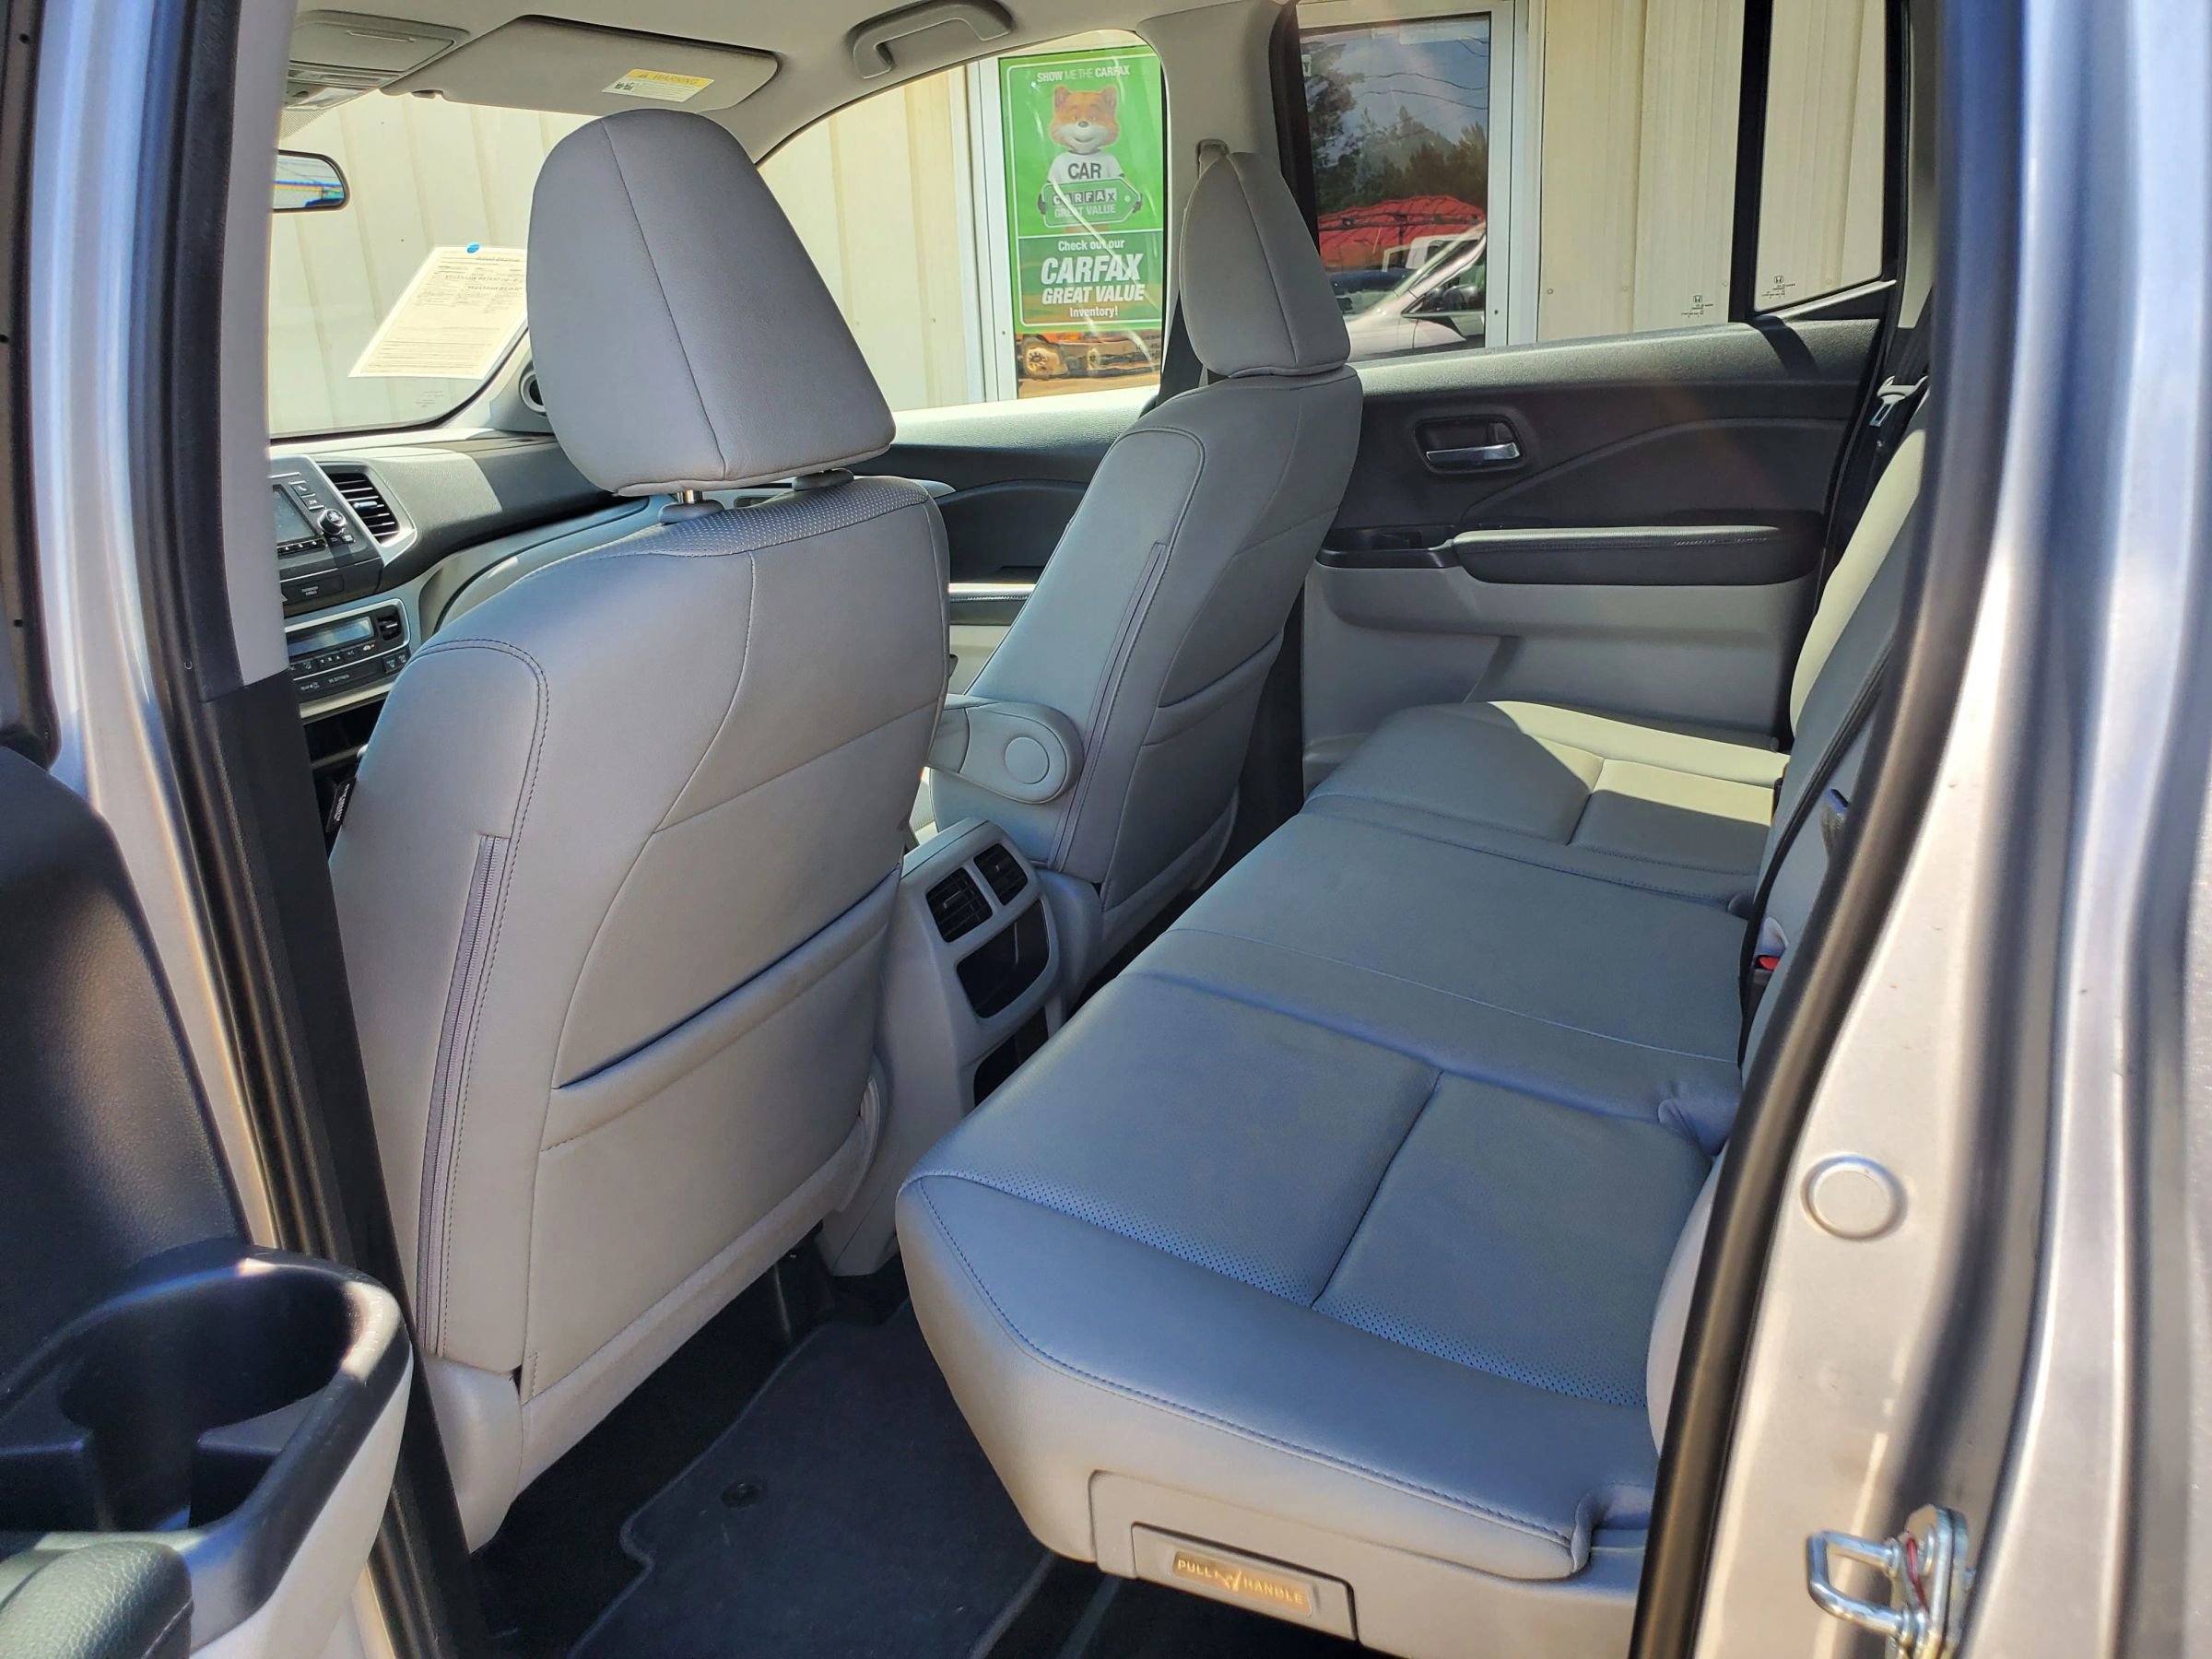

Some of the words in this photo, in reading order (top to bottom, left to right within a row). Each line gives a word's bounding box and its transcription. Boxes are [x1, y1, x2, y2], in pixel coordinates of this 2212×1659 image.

[1037, 70, 1064, 82] SHOW
[1065, 69, 1077, 80] ME
[1078, 68, 1094, 78] THE
[1095, 65, 1131, 77] CARFAX
[1067, 162, 1102, 180] CAR
[1054, 207, 1083, 218] GRET
[1086, 204, 1116, 215] VALUE
[1058, 240, 1088, 252] Check
[1089, 239, 1106, 250] out
[1108, 239, 1125, 249] our
[1041, 253, 1144, 285] CARFAX
[1041, 287, 1093, 305] GREAT
[1095, 284, 1146, 302] VALUE
[1069, 306, 1119, 318] Inventory!
[1177, 1559, 1213, 1579] PULL
[1243, 1579, 1304, 1605] HANDLE
